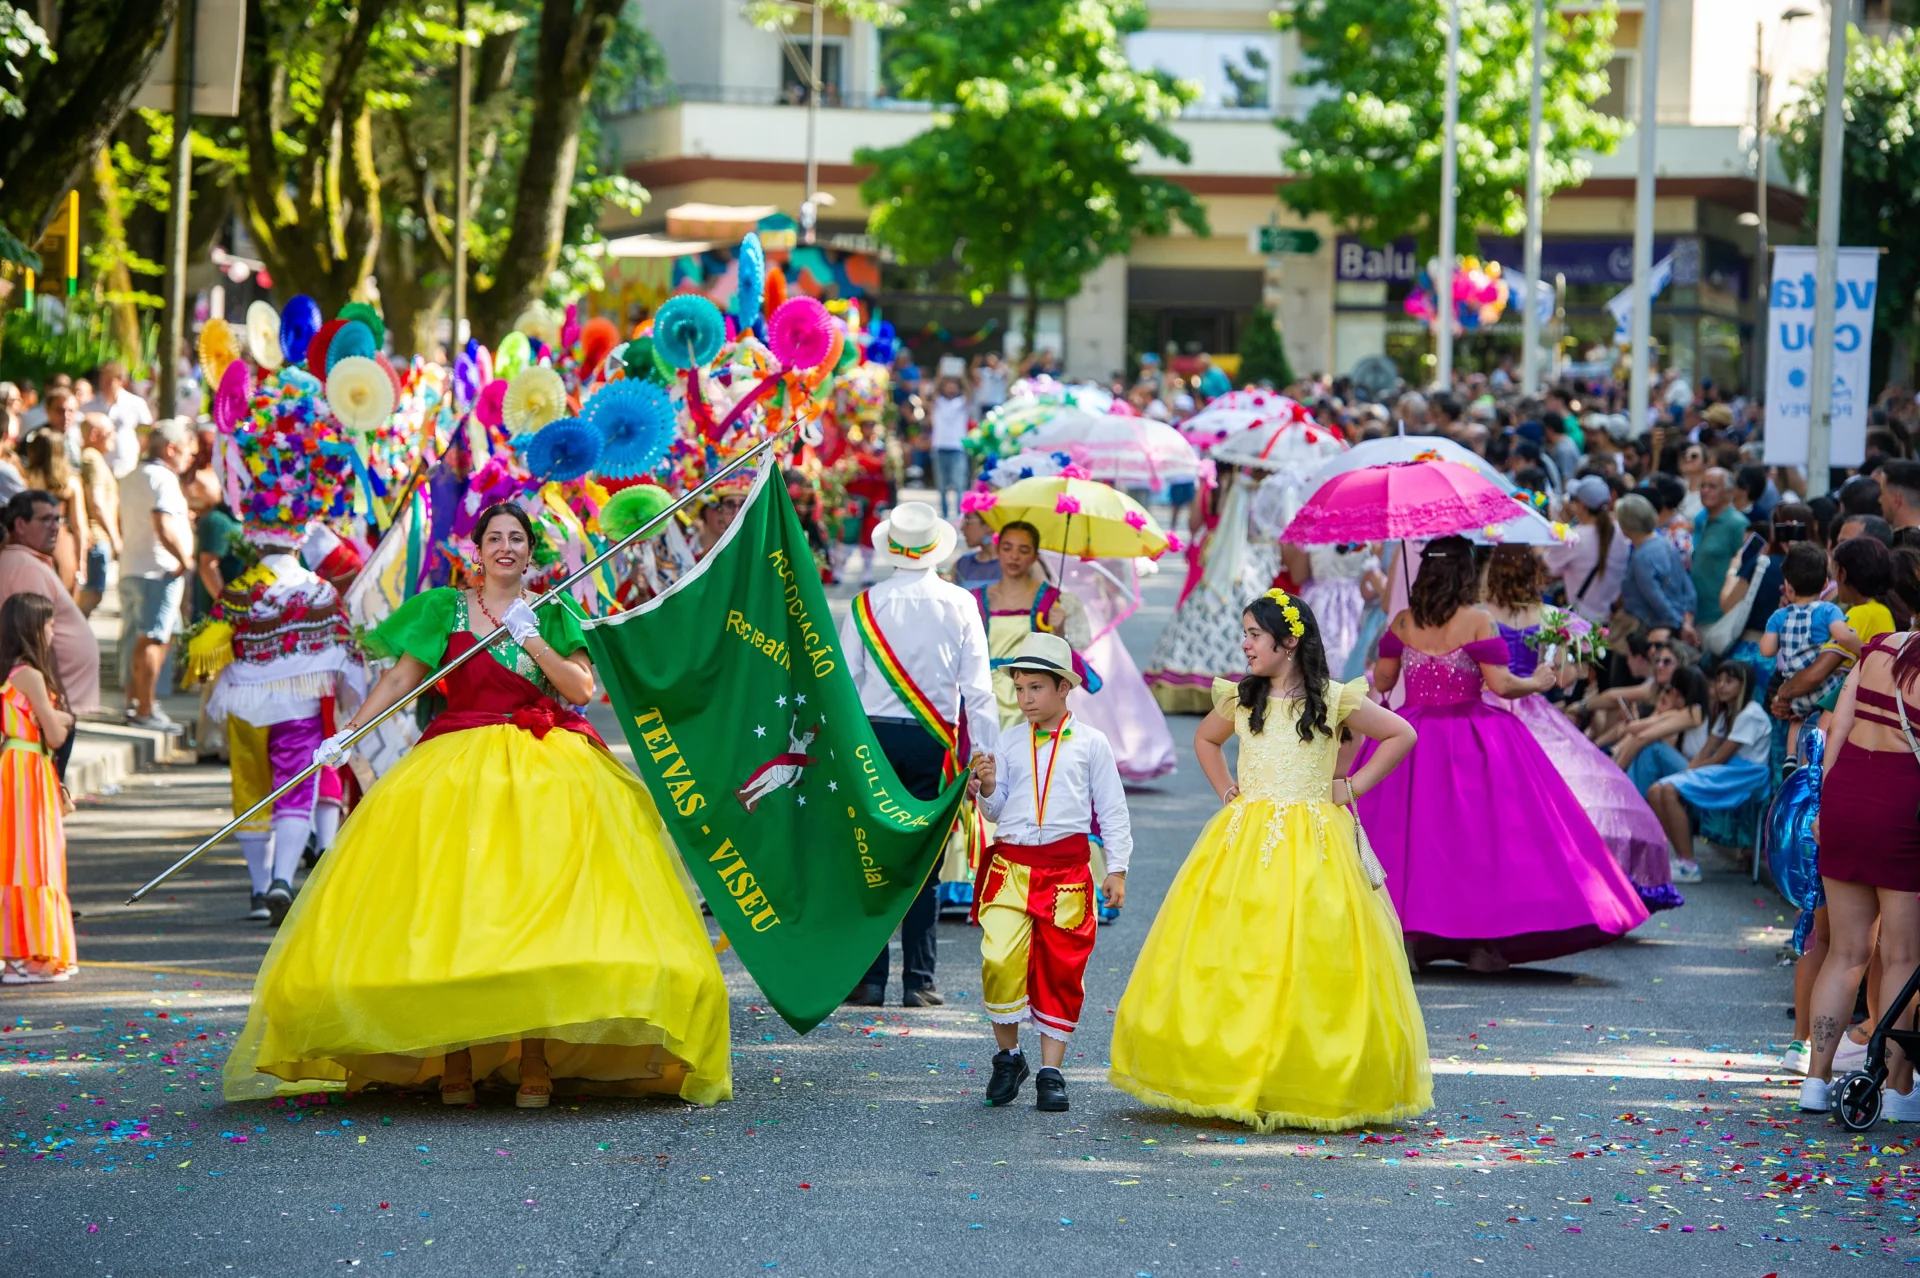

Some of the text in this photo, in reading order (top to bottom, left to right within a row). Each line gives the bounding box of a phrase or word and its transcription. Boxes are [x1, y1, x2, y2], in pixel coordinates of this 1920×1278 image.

[1340, 243, 1417, 279] Balu
[634, 707, 707, 817] TEIVAS
[708, 838, 781, 933] VISEU
